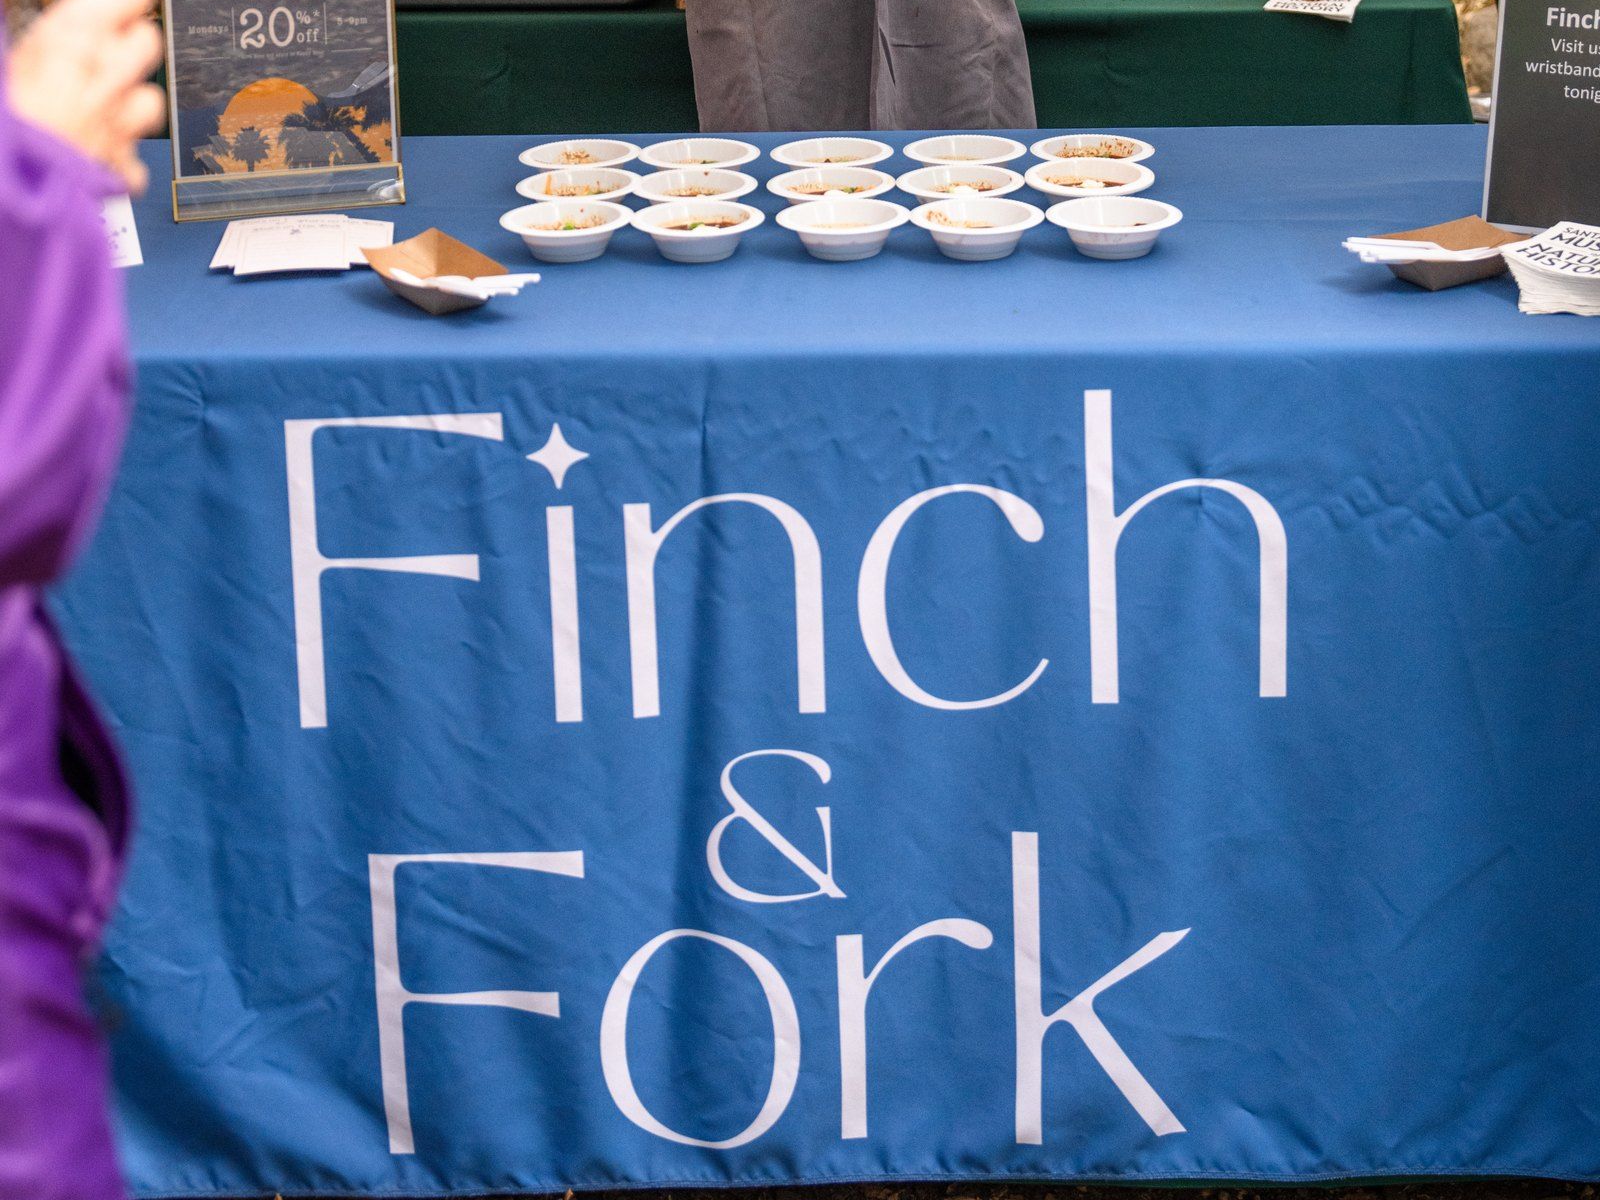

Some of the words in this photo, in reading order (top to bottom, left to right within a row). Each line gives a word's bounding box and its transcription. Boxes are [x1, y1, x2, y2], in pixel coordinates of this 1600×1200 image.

[188, 25, 229, 35] Mondays
[297, 29, 319, 43] off
[1551, 38, 1584, 54] Visit
[1564, 227, 1600, 240] SANT
[284, 389, 1287, 728] Finch
[706, 748, 847, 903] &
[368, 830, 1192, 1154] Fork
